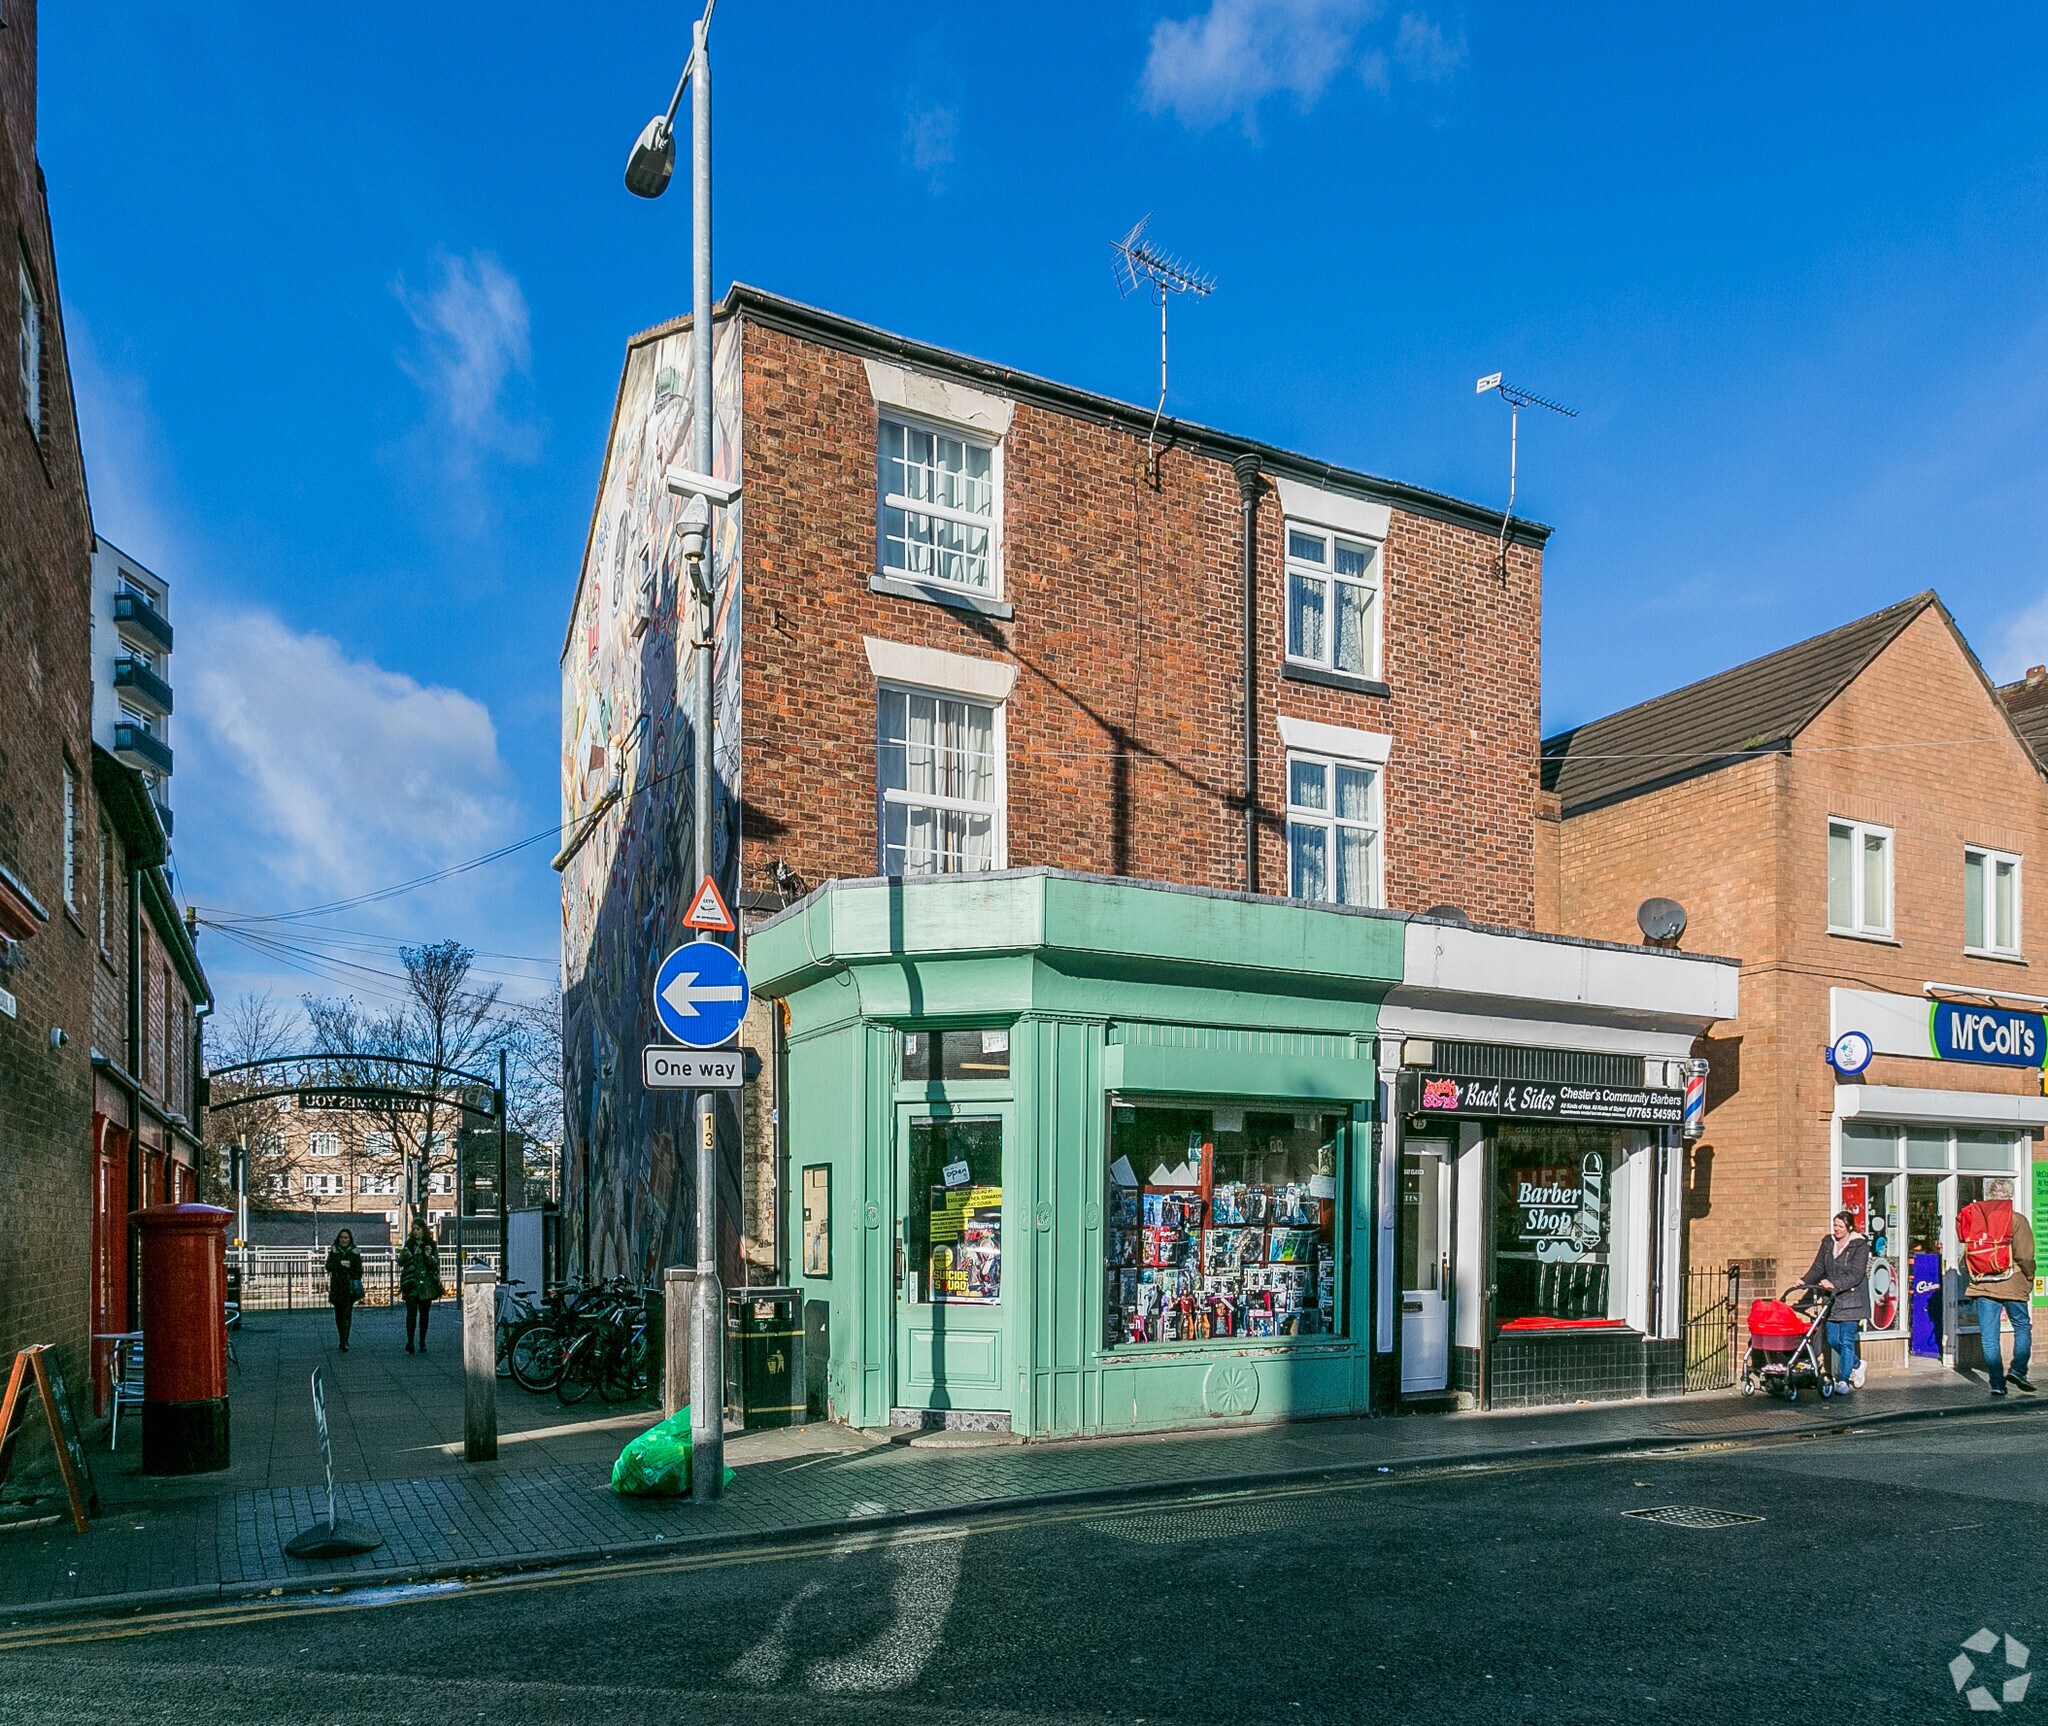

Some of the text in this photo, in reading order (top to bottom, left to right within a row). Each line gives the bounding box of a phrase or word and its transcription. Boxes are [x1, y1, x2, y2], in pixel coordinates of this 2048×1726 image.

[1951, 1011, 2035, 1057] McColl's
[655, 1058, 735, 1080] One way
[1464, 1082, 1499, 1107] Back
[1504, 1086, 1517, 1112] &
[1520, 1086, 1557, 1110] Sides
[1560, 1086, 1681, 1106] Chester's Community Barbers
[1625, 1106, 1681, 1121] 07765 545963
[946, 1167, 968, 1181] open
[1517, 1182, 1582, 1204] Barber
[1526, 1209, 1572, 1235] Shop
[933, 1270, 969, 1281] SUICIDE
[935, 1280, 967, 1291] SUAD
